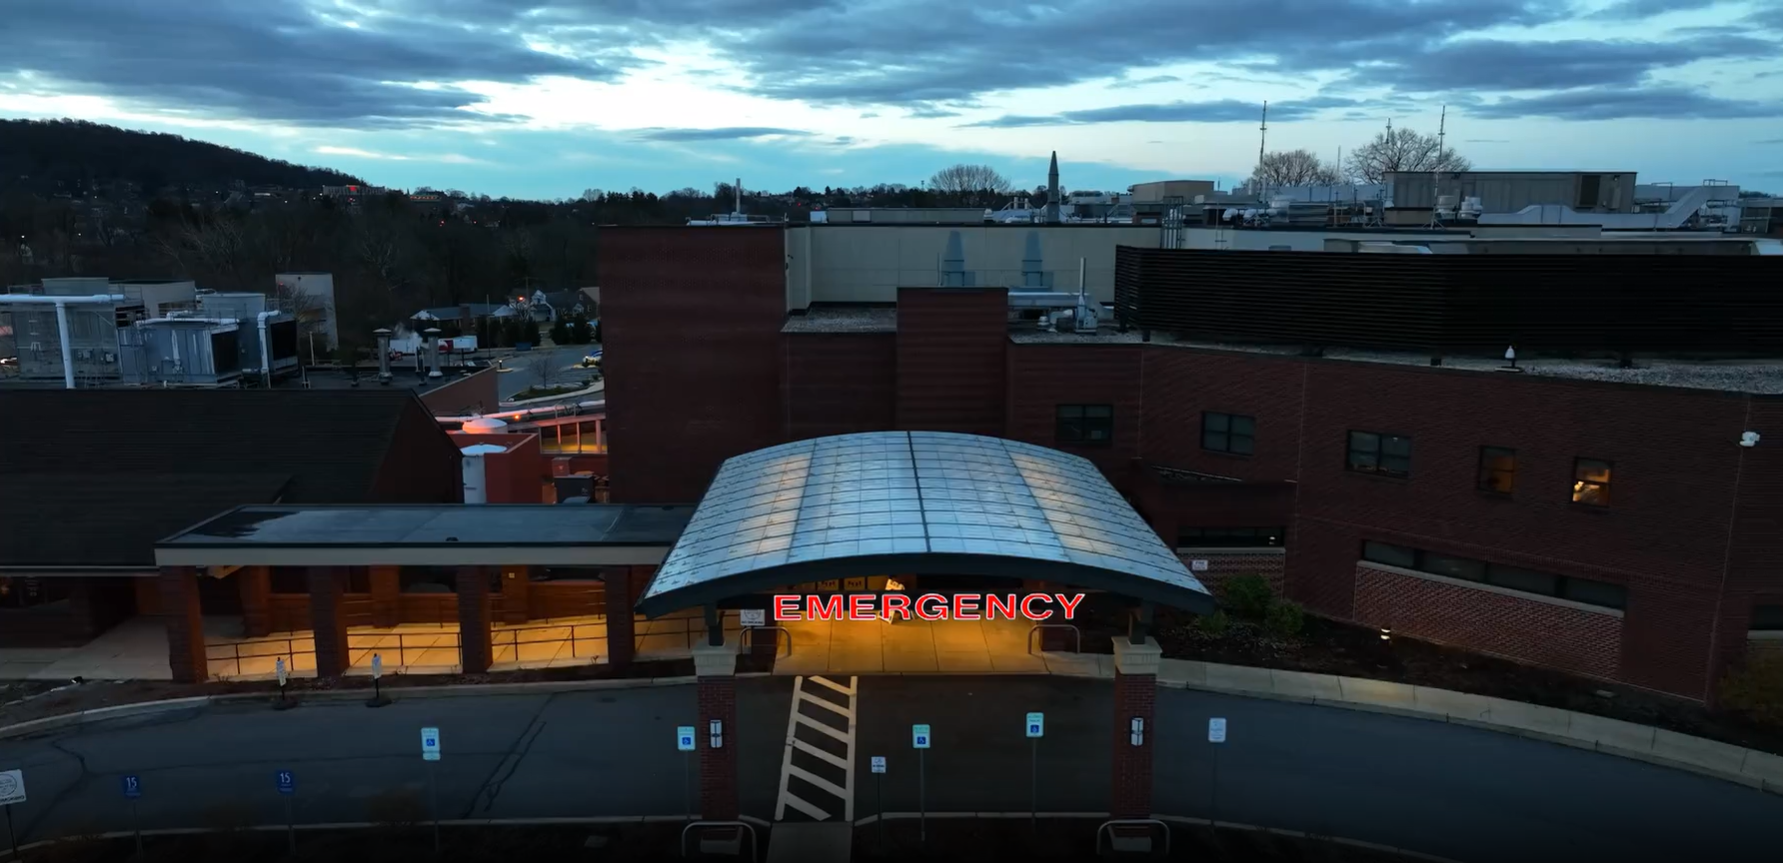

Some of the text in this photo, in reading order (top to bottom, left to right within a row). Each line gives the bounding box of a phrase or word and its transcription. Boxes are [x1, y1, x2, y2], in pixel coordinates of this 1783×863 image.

[774, 594, 1085, 621] EMERGENCY
[126, 776, 137, 788] 15
[280, 772, 291, 783] 15
